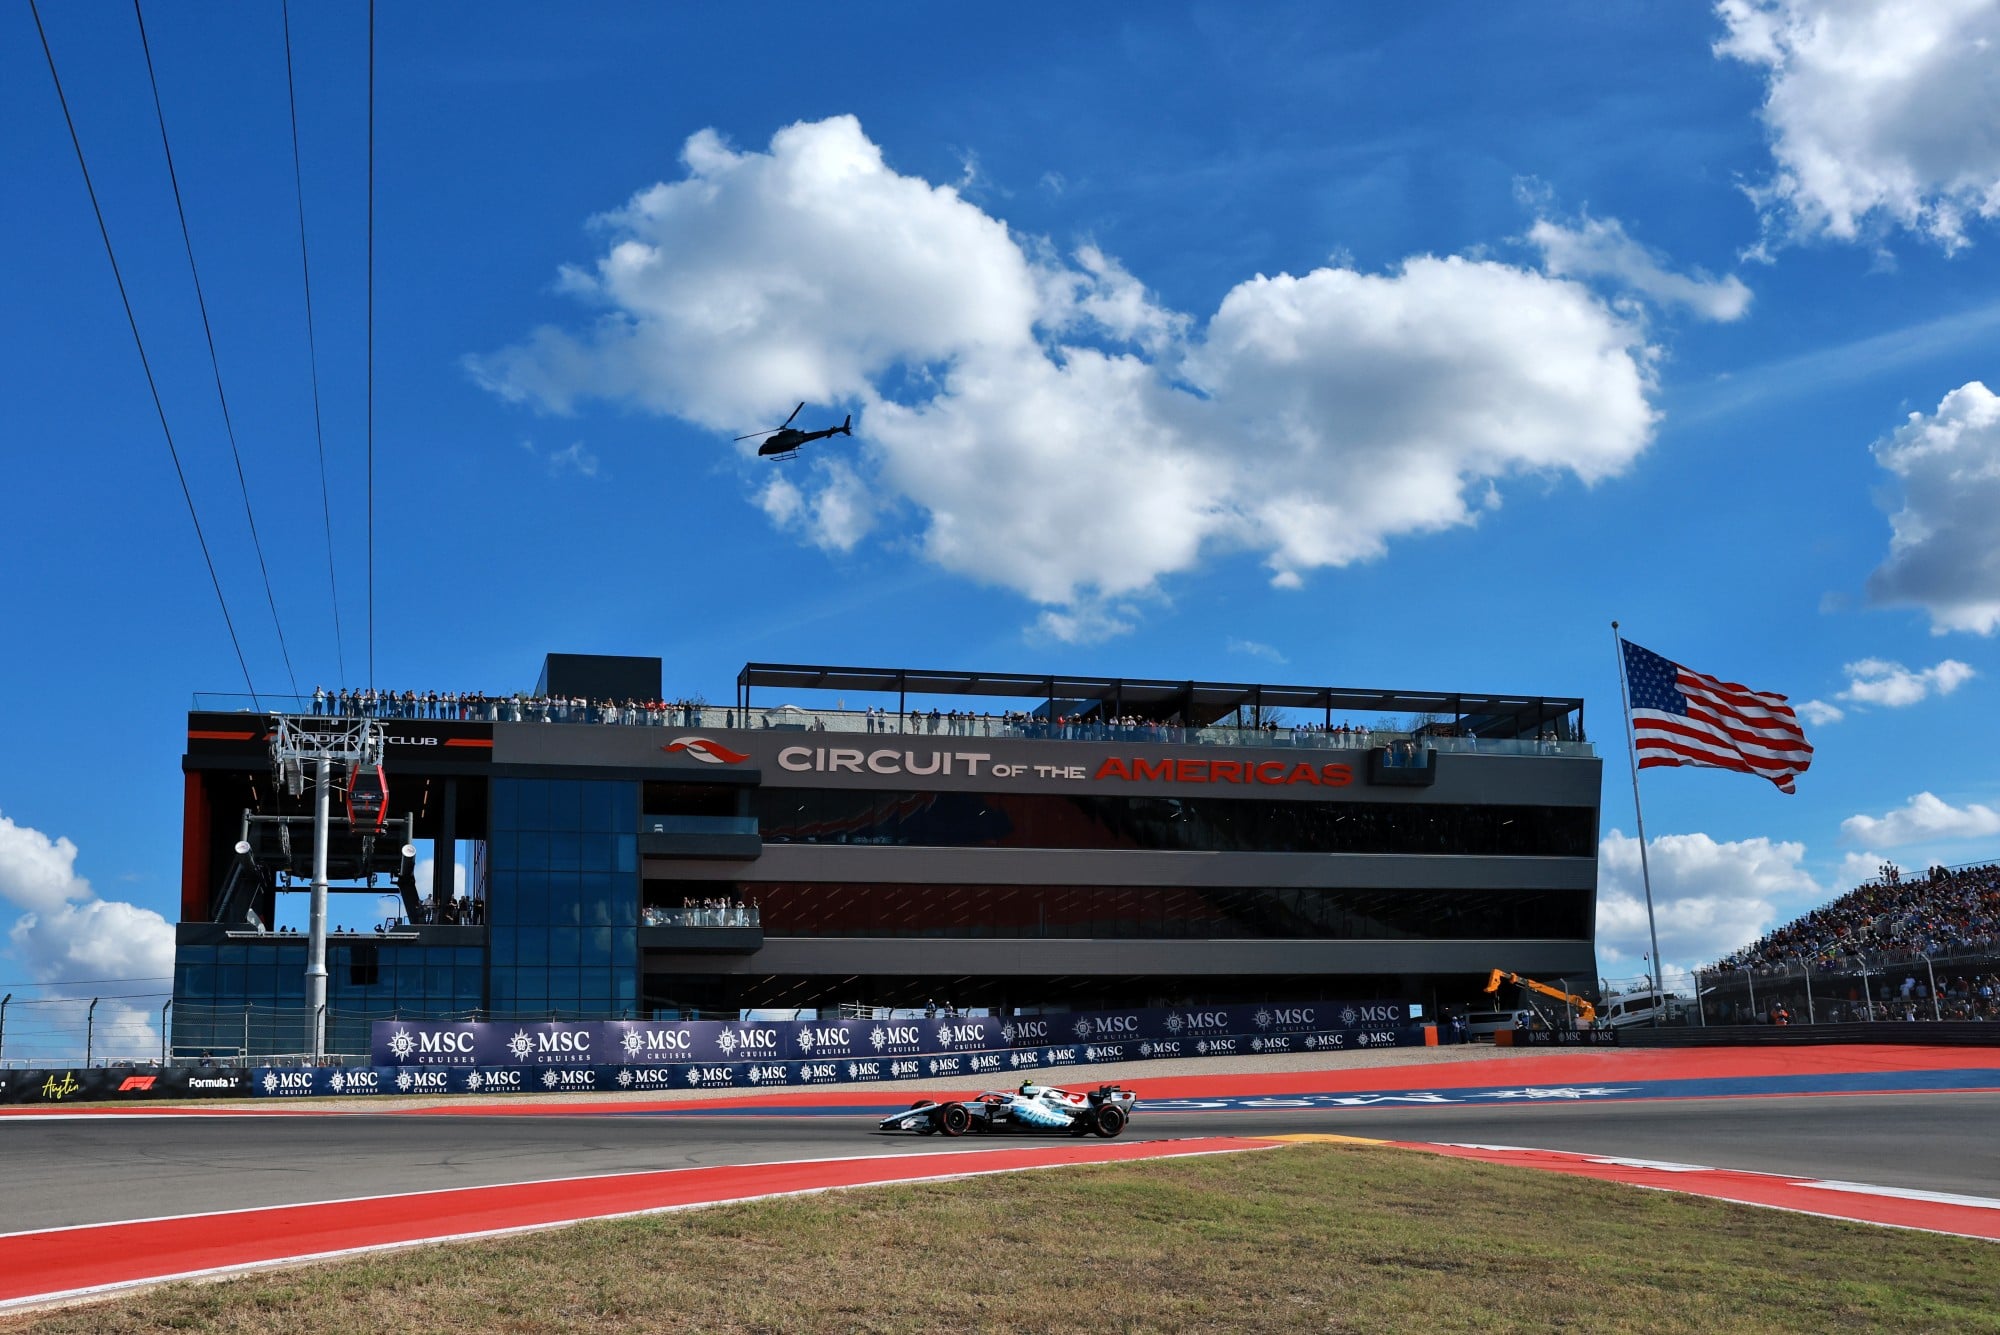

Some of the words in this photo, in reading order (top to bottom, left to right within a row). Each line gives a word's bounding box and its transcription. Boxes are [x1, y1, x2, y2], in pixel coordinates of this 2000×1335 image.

[388, 736, 437, 745] CLUB
[777, 746, 990, 776] CIRCUIT
[992, 763, 1030, 776] OF
[1034, 765, 1085, 779] THE
[1095, 756, 1353, 787] AMERICAS
[1275, 1009, 1314, 1024] MSC
[1361, 1006, 1399, 1021] MSC
[1095, 1016, 1138, 1032] MSC
[1186, 1012, 1227, 1028] MSC
[887, 1027, 919, 1044] MSC
[954, 1025, 984, 1041] MSC
[1017, 1022, 1047, 1038] MSC
[1536, 1032, 1549, 1040] MSC
[1566, 1032, 1580, 1040] MSC
[1598, 1032, 1613, 1040] MSC
[419, 1032, 474, 1052] MSC
[538, 1032, 590, 1052] MSC
[647, 1031, 690, 1049] MSC
[740, 1030, 776, 1048] MSC
[816, 1028, 849, 1046] MSC
[1264, 1038, 1289, 1048] MSC
[1318, 1035, 1342, 1045] MSC
[1371, 1032, 1394, 1042] MSC
[1154, 1042, 1180, 1052] MSC
[1210, 1040, 1236, 1050] MSC
[1020, 1052, 1038, 1063] MSC
[1056, 1049, 1075, 1059] MSC
[1097, 1046, 1122, 1057] MSC
[900, 1061, 918, 1072] MSC
[940, 1058, 959, 1070] MSC
[980, 1056, 1000, 1066] MSC
[703, 1068, 732, 1080] MSC
[762, 1066, 786, 1078] MSC
[813, 1064, 836, 1076] MSC
[859, 1063, 879, 1074] MSC
[280, 1073, 312, 1087] MSC
[347, 1072, 377, 1086] MSC
[414, 1072, 446, 1086] MSC
[485, 1071, 520, 1084] MSC
[561, 1071, 595, 1083] MSC
[636, 1069, 668, 1082] MSC
[42, 1071, 78, 1099] Austin
[189, 1078, 228, 1088] Formula
